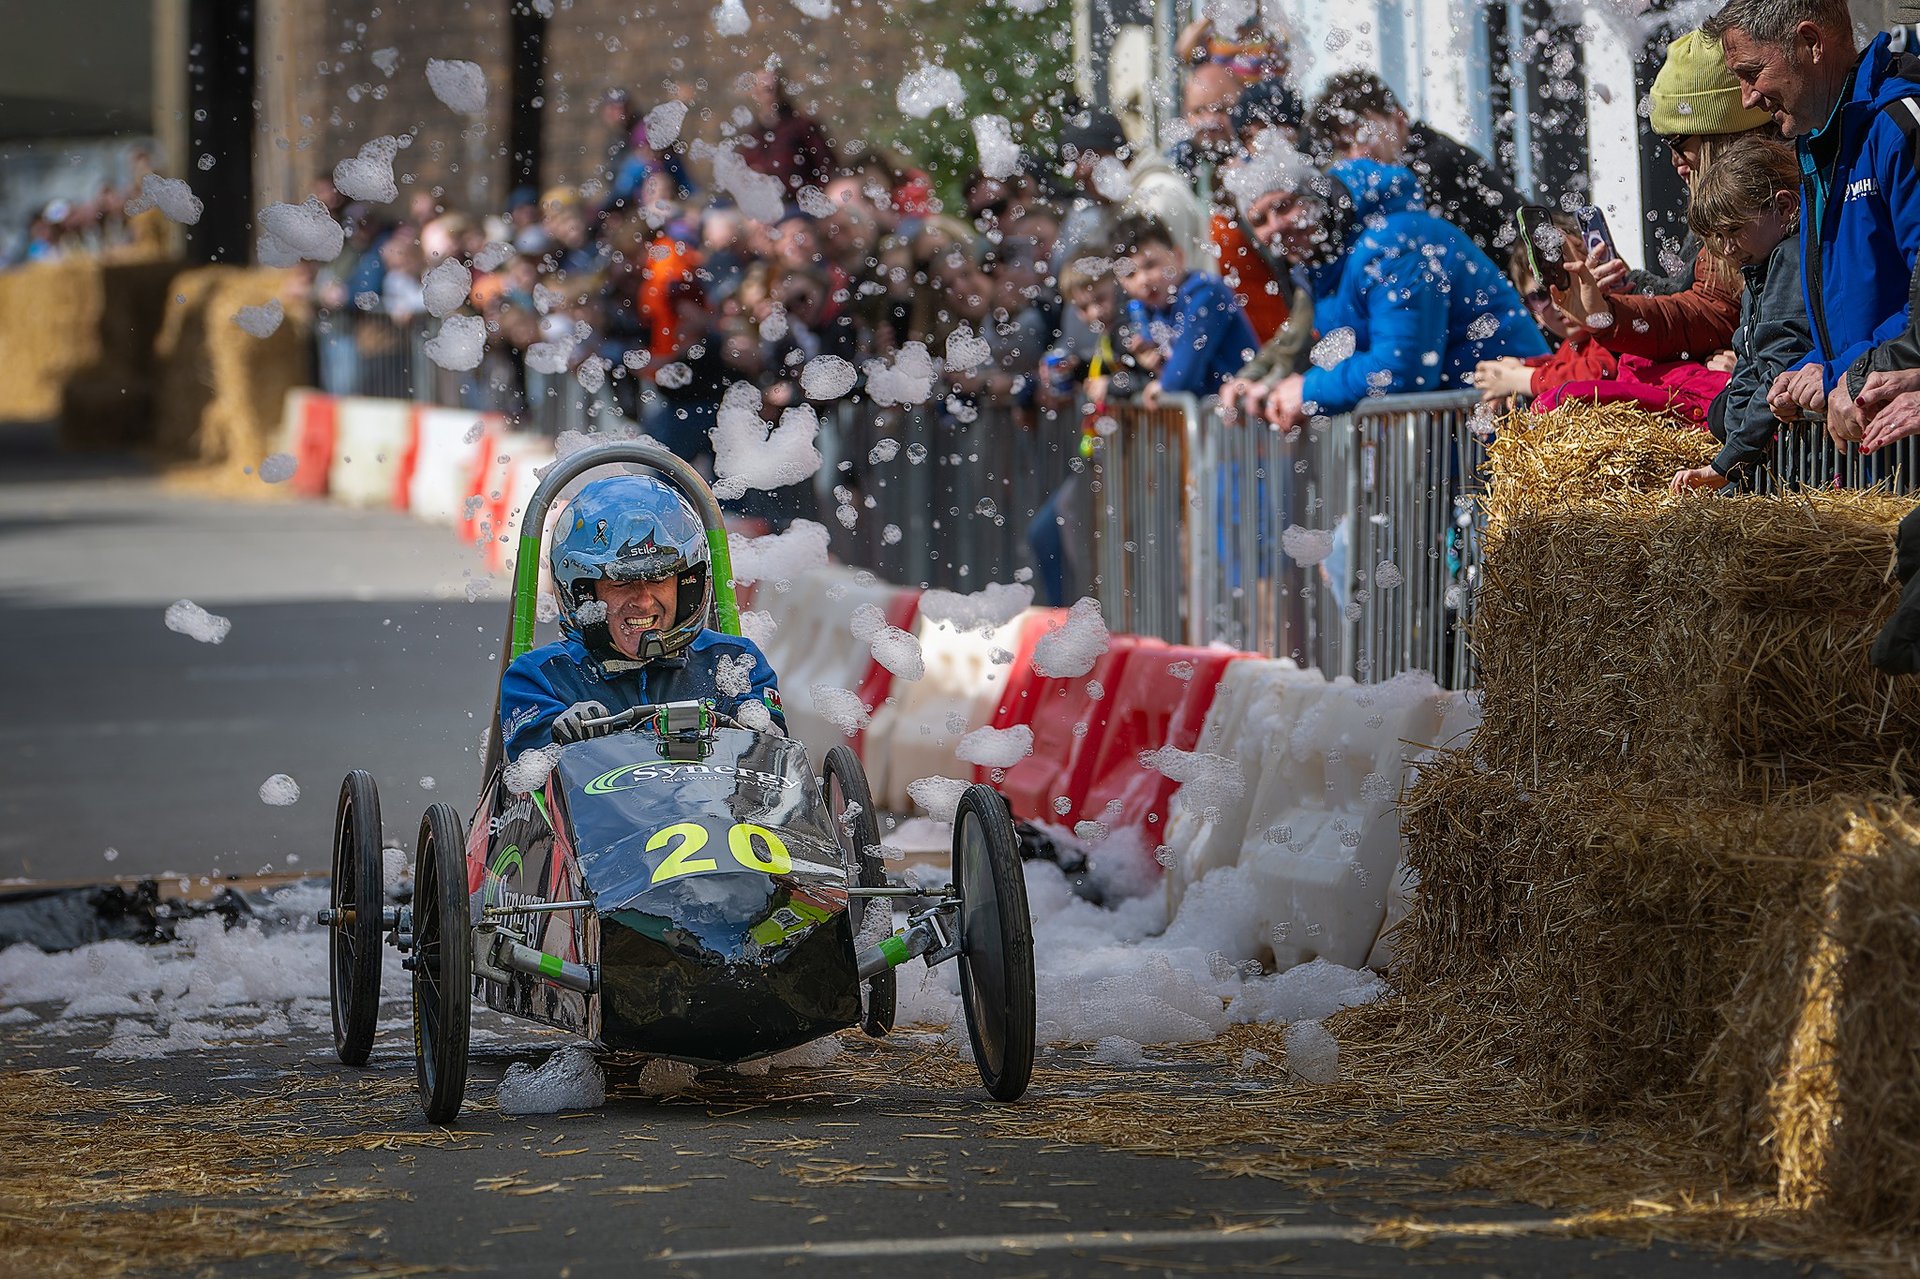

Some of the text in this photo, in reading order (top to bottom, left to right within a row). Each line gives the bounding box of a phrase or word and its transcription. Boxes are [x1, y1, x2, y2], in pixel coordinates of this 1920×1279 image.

[632, 765, 800, 789] Synergy
[662, 775, 782, 791] Network Services
[645, 823, 793, 884] 20
